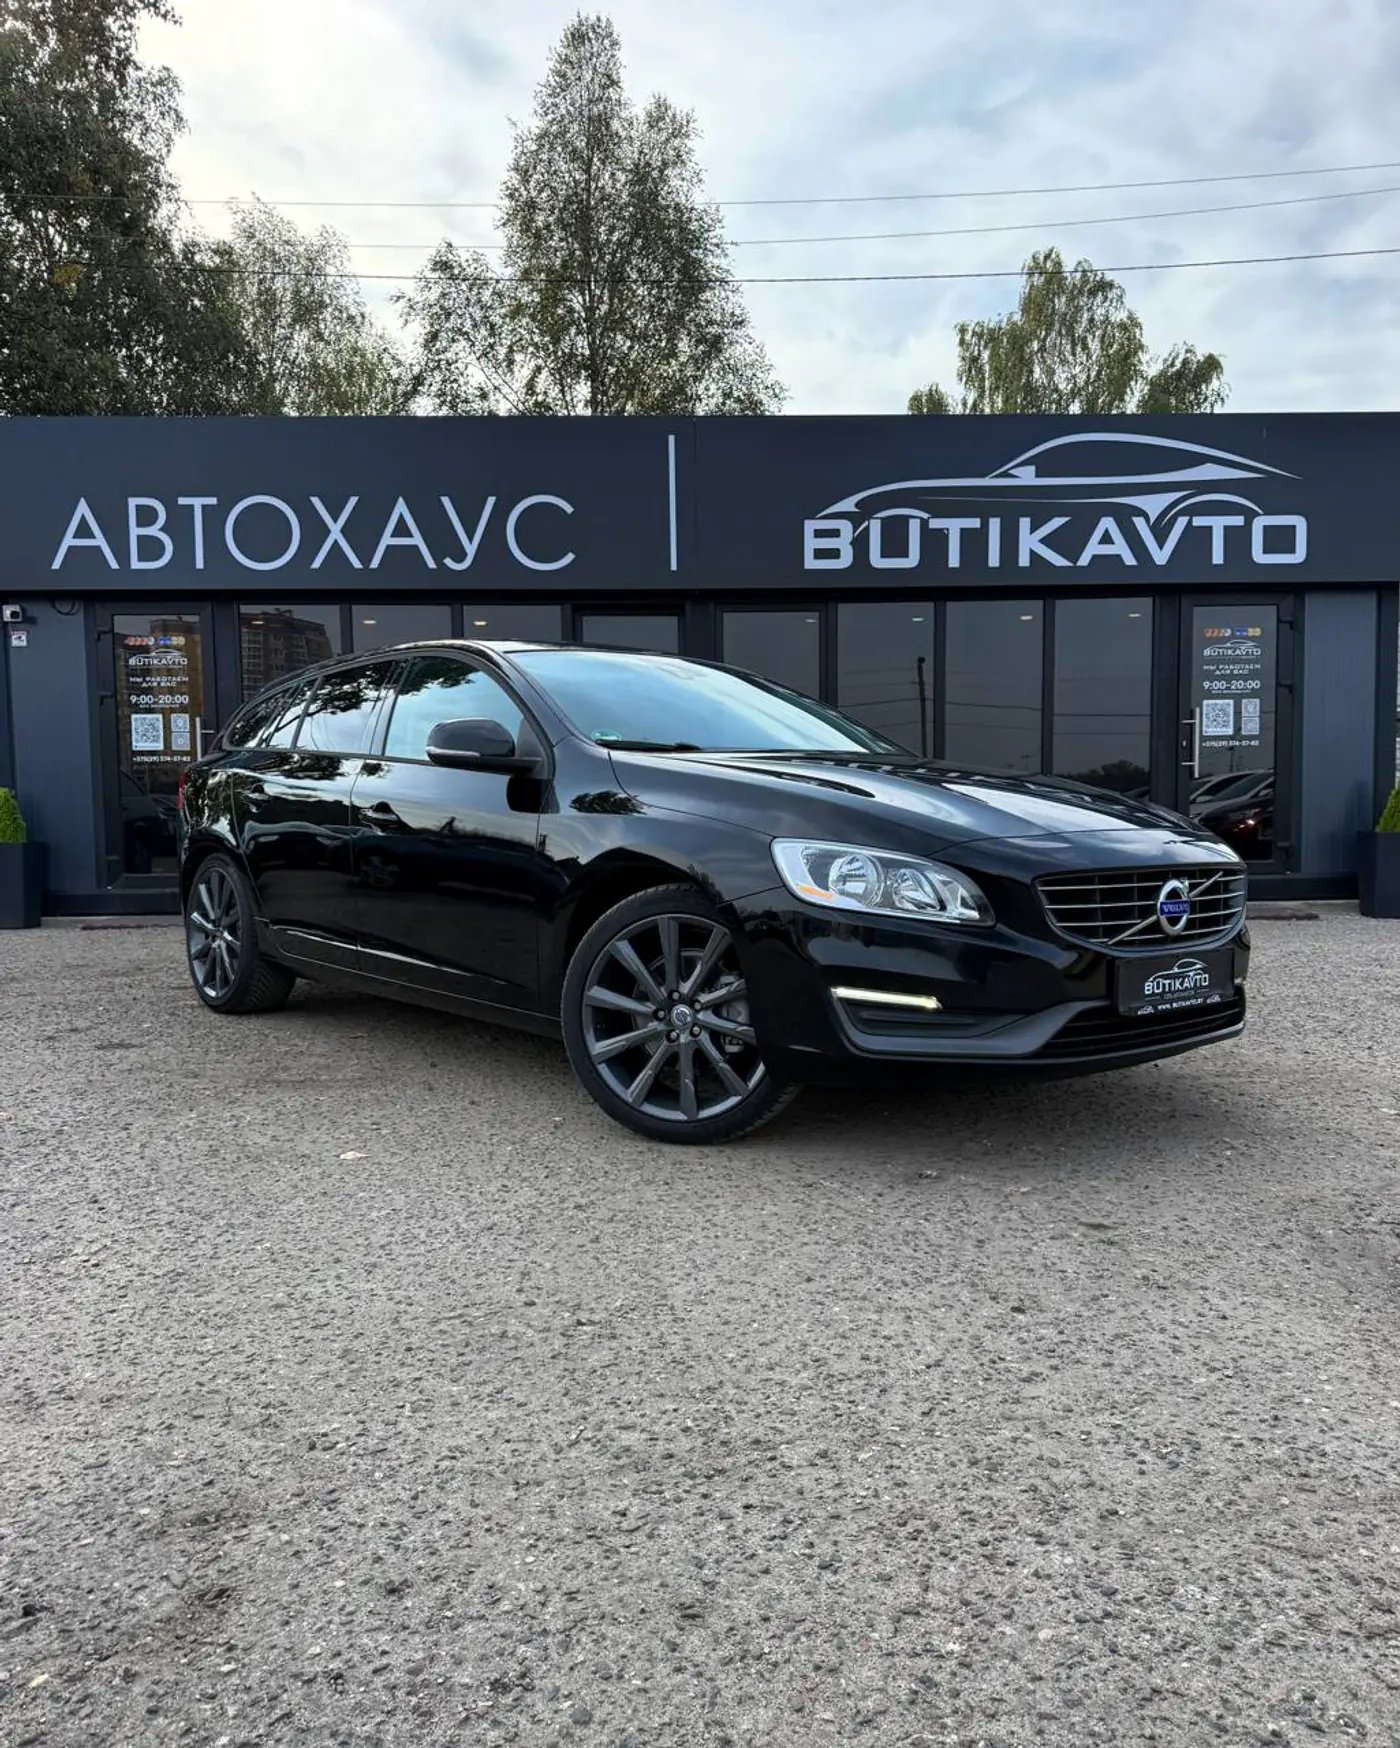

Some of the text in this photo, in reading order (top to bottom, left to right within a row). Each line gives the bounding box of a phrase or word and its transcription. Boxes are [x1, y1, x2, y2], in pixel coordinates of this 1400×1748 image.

[51, 495, 576, 571] АВТОХАУС
[803, 514, 1308, 570] BUTIKAVTO
[1203, 648, 1261, 657] BUTIKAVTO
[129, 657, 188, 666] BUTIKAVTO
[1203, 680, 1260, 690] 9:00-20:00
[130, 694, 189, 704] 9:00-20:00
[1144, 973, 1209, 995] BUTIKAVTO
